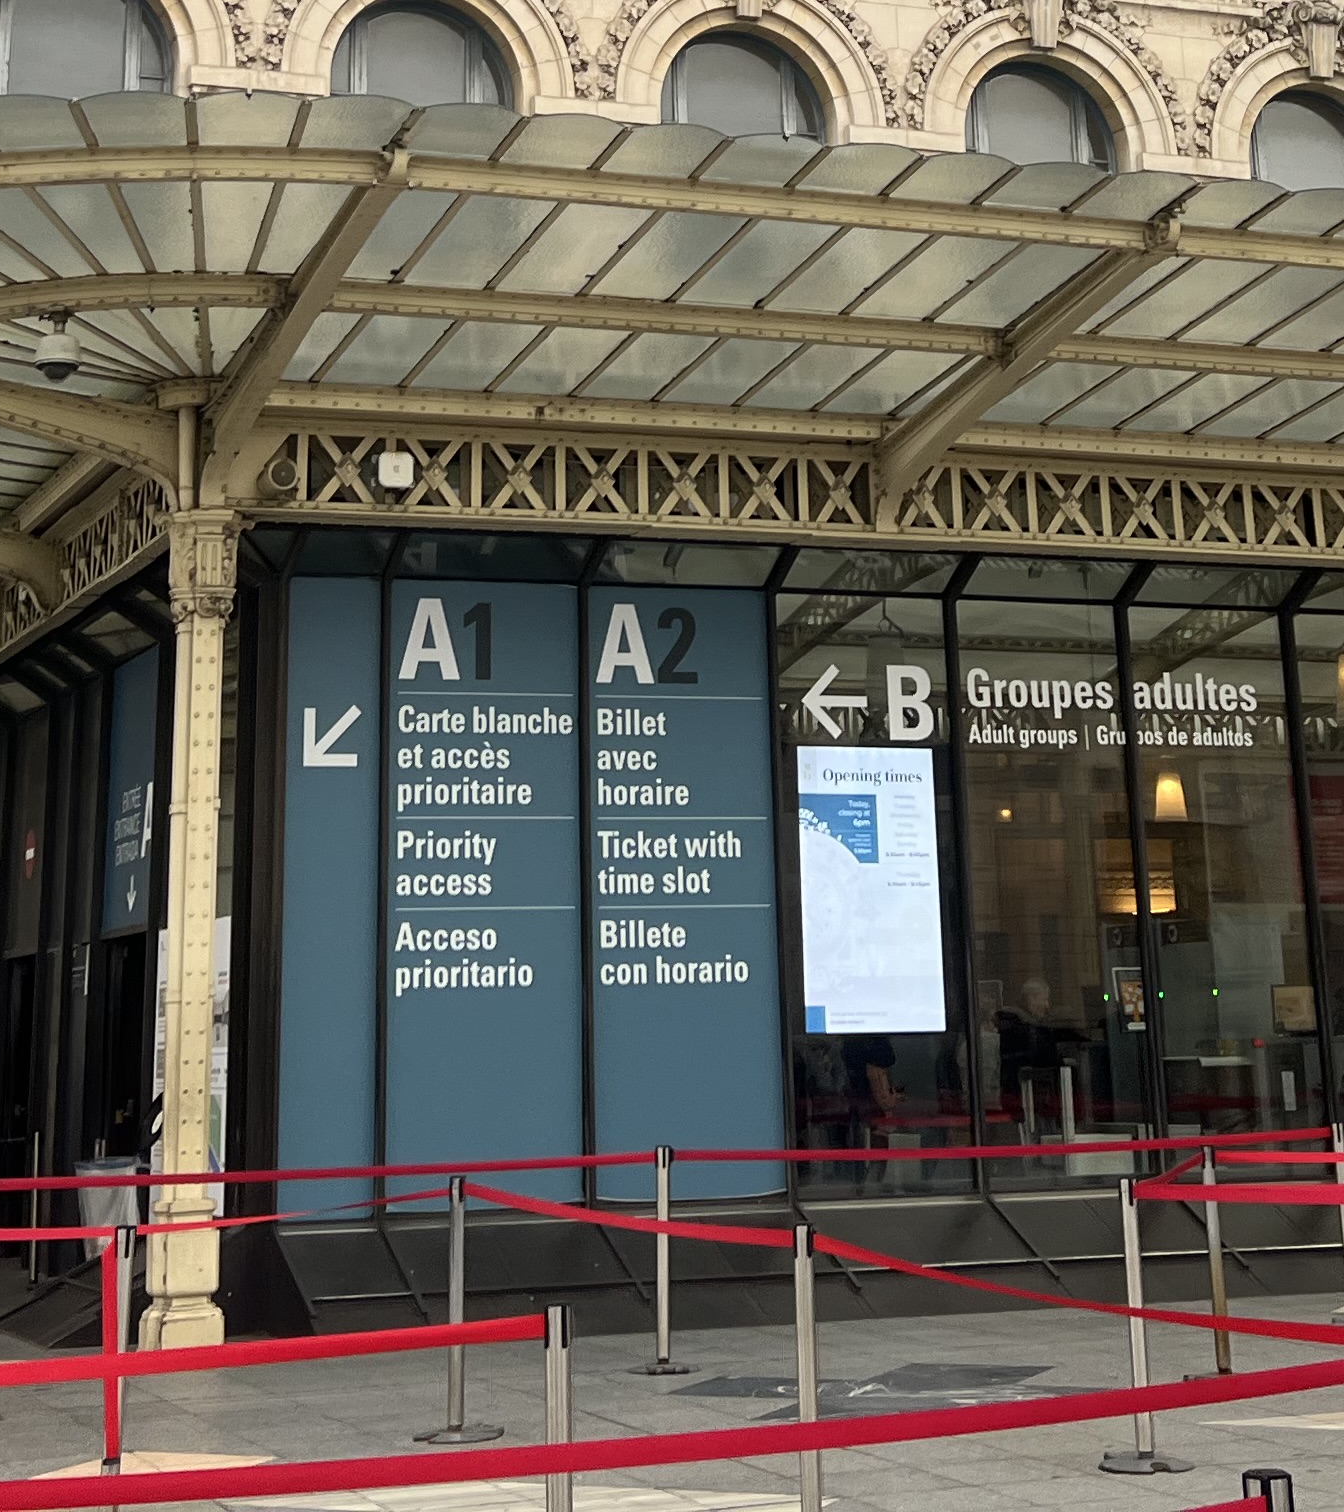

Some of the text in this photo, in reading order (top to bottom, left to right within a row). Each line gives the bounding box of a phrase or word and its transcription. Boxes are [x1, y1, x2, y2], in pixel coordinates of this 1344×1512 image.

[397, 597, 492, 681] A1
[595, 602, 699, 685] A2
[885, 664, 935, 741] B
[966, 667, 1258, 719] Groupes adultes
[397, 704, 574, 736] Carte blanche
[596, 708, 667, 737] Billet
[968, 724, 1254, 750] Adult groups Gruos de adultos
[397, 740, 510, 770] et accès
[596, 749, 658, 772] avec
[596, 777, 690, 807] horaire
[823, 768, 882, 786] Opening
[885, 769, 923, 783] times
[397, 776, 533, 813] prioritaire
[396, 830, 498, 865] Priority
[596, 830, 742, 860] Ticket with
[396, 873, 493, 897] access
[597, 864, 712, 895] time slot
[394, 920, 498, 952] Acceso
[599, 919, 687, 949] Billete
[395, 956, 534, 997] prioritario
[599, 953, 750, 986] con horario
